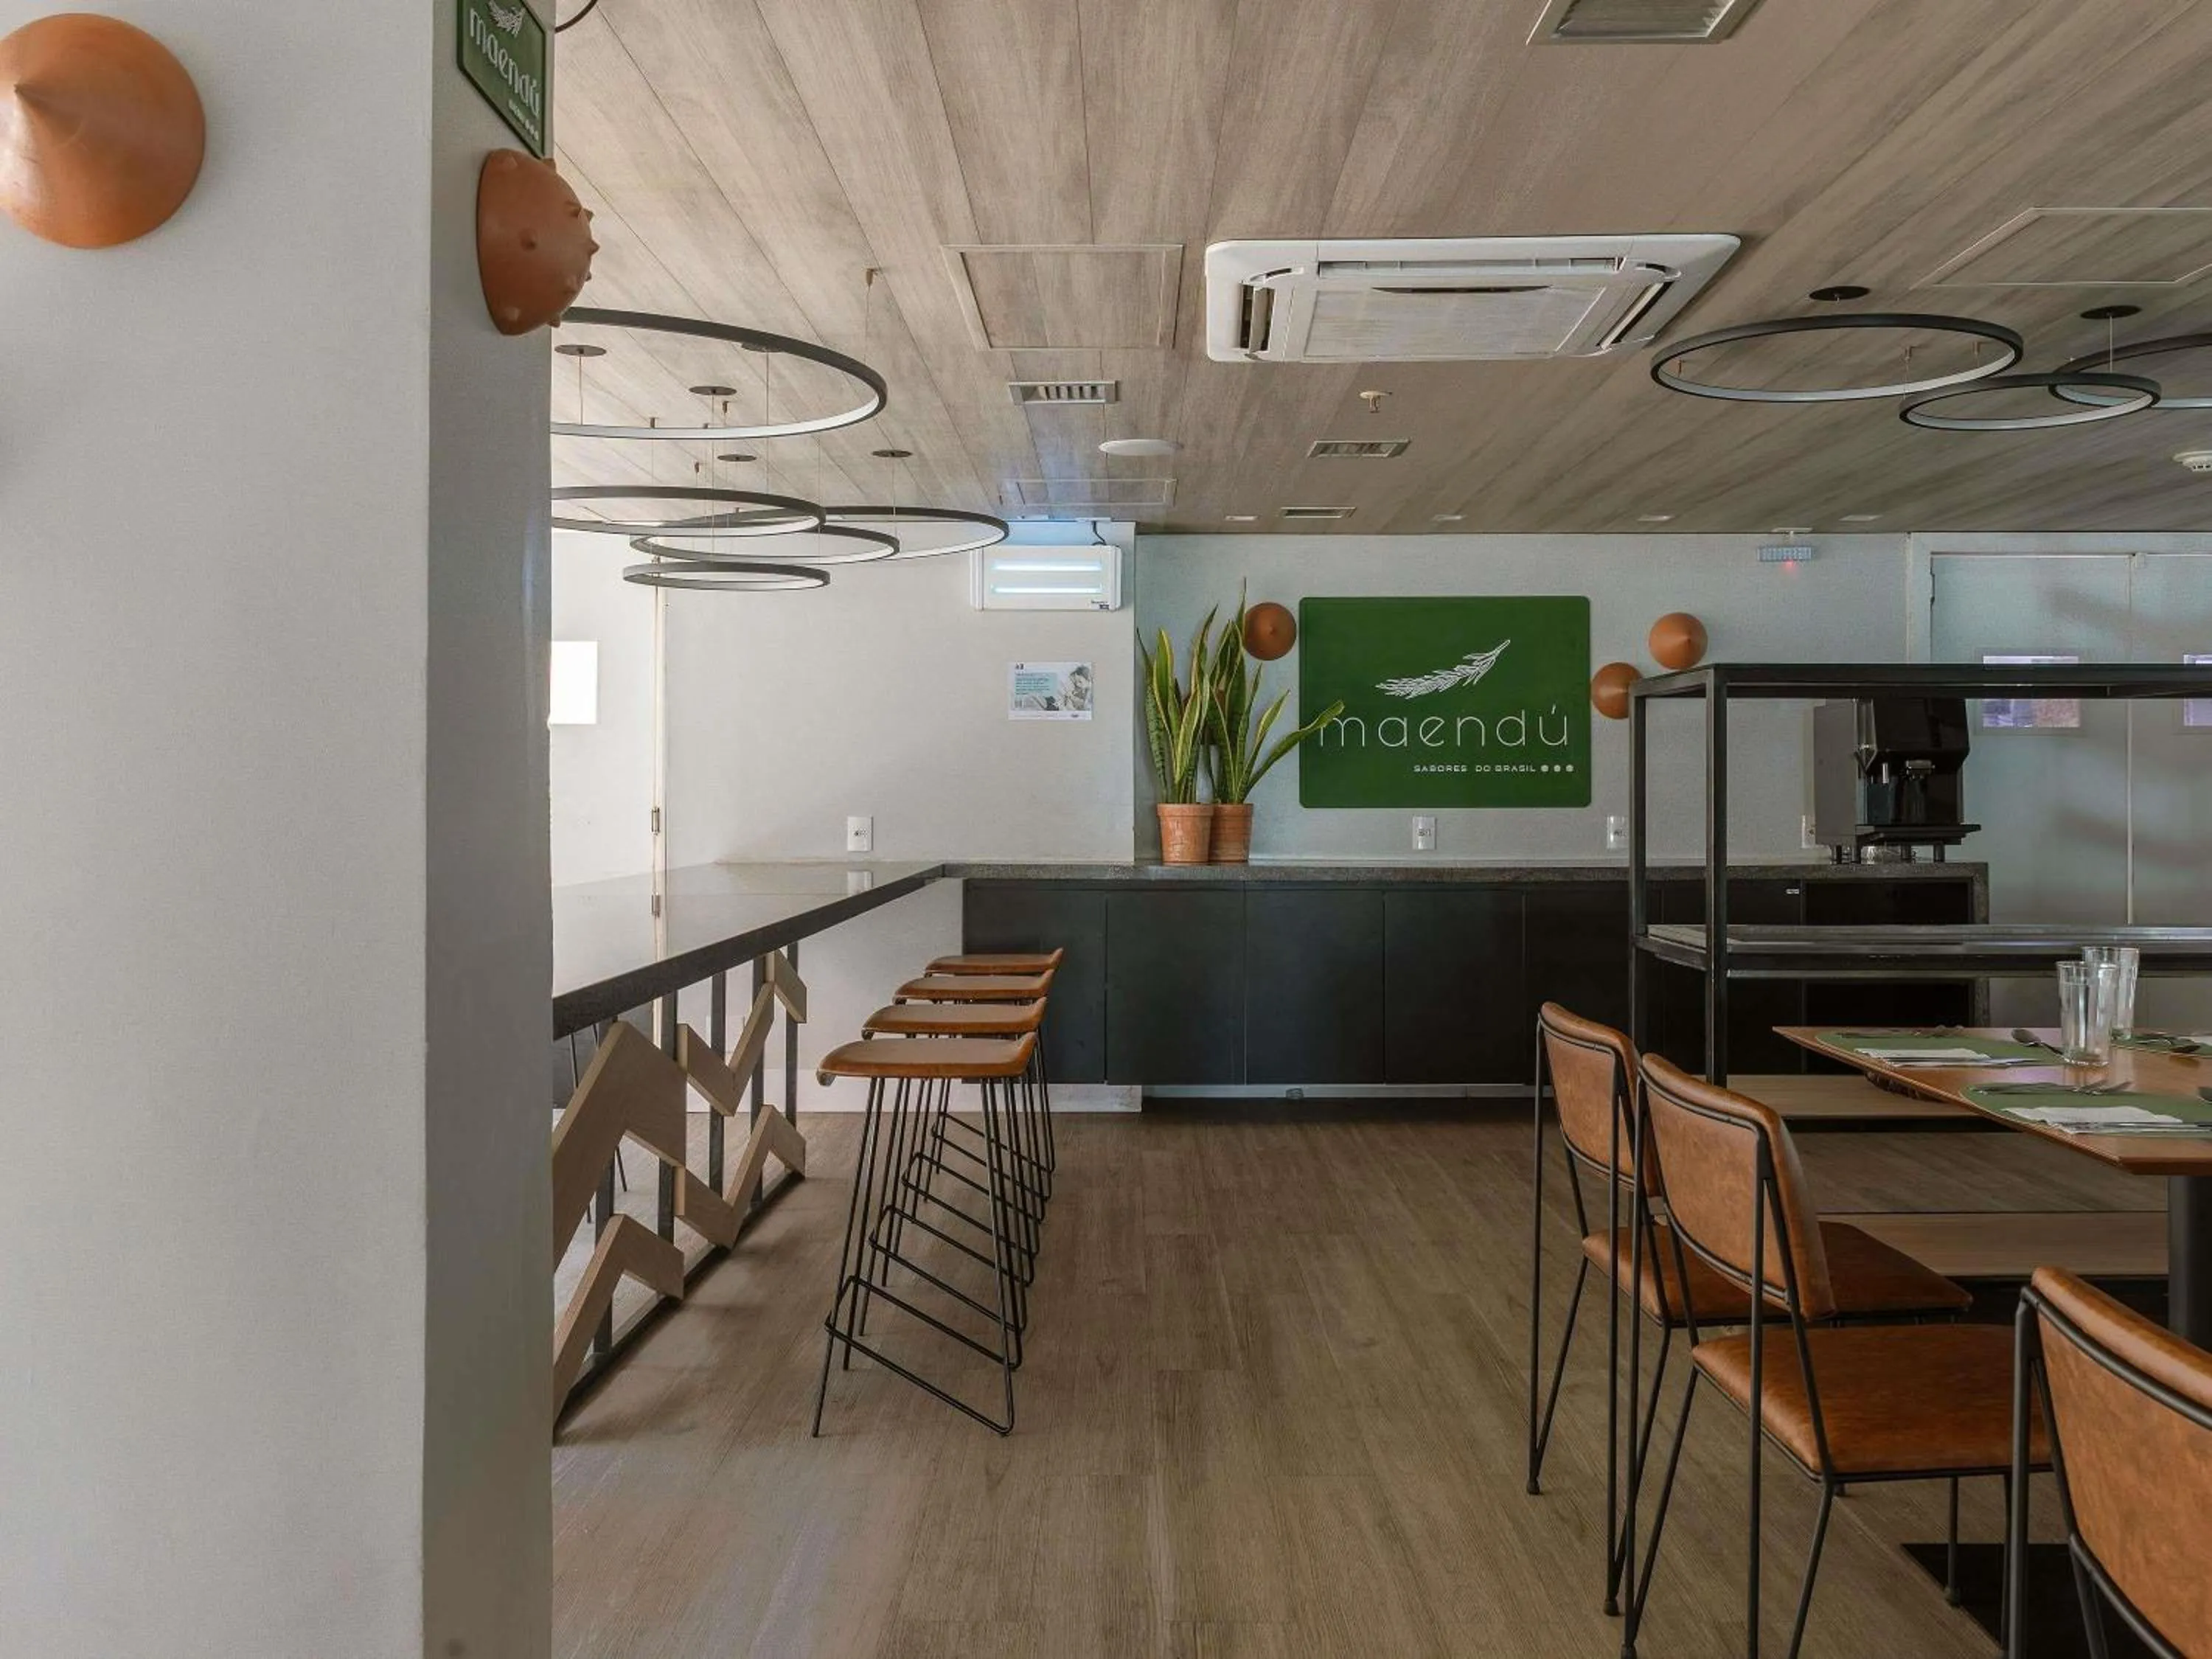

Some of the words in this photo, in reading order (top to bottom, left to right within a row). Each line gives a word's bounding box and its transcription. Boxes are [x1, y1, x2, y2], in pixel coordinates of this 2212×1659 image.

[1318, 703, 1568, 748] maendú
[1413, 764, 1468, 773] SABORES
[1475, 764, 1492, 773] DO
[1494, 764, 1537, 773] BRASIL
